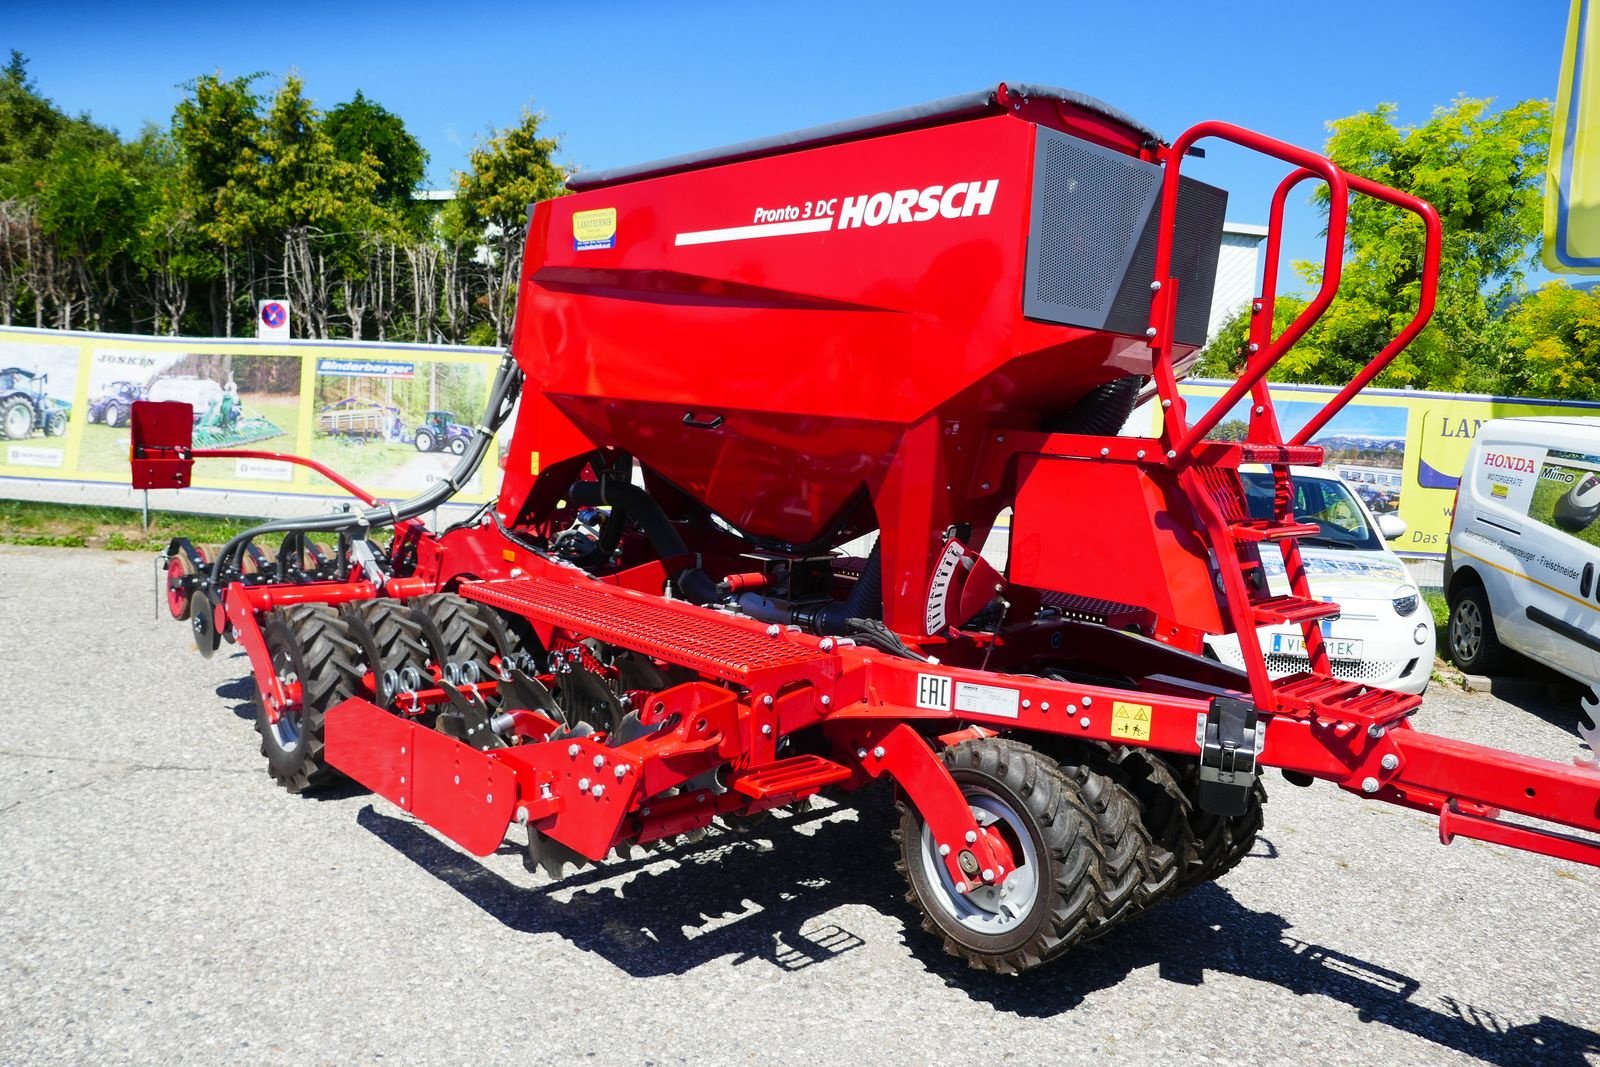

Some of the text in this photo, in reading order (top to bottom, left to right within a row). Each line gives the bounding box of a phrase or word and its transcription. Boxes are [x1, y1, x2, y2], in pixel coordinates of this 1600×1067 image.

[753, 199, 838, 223] Pronto 3 DC
[837, 179, 1000, 230] HORSCH
[320, 360, 413, 375] Binderberger
[1484, 453, 1535, 473] HONDA
[1487, 472, 1523, 487] MOTORGERÄTE
[1412, 530, 1438, 544] Das
[1287, 638, 1300, 652] VI
[920, 676, 948, 707] EAC
